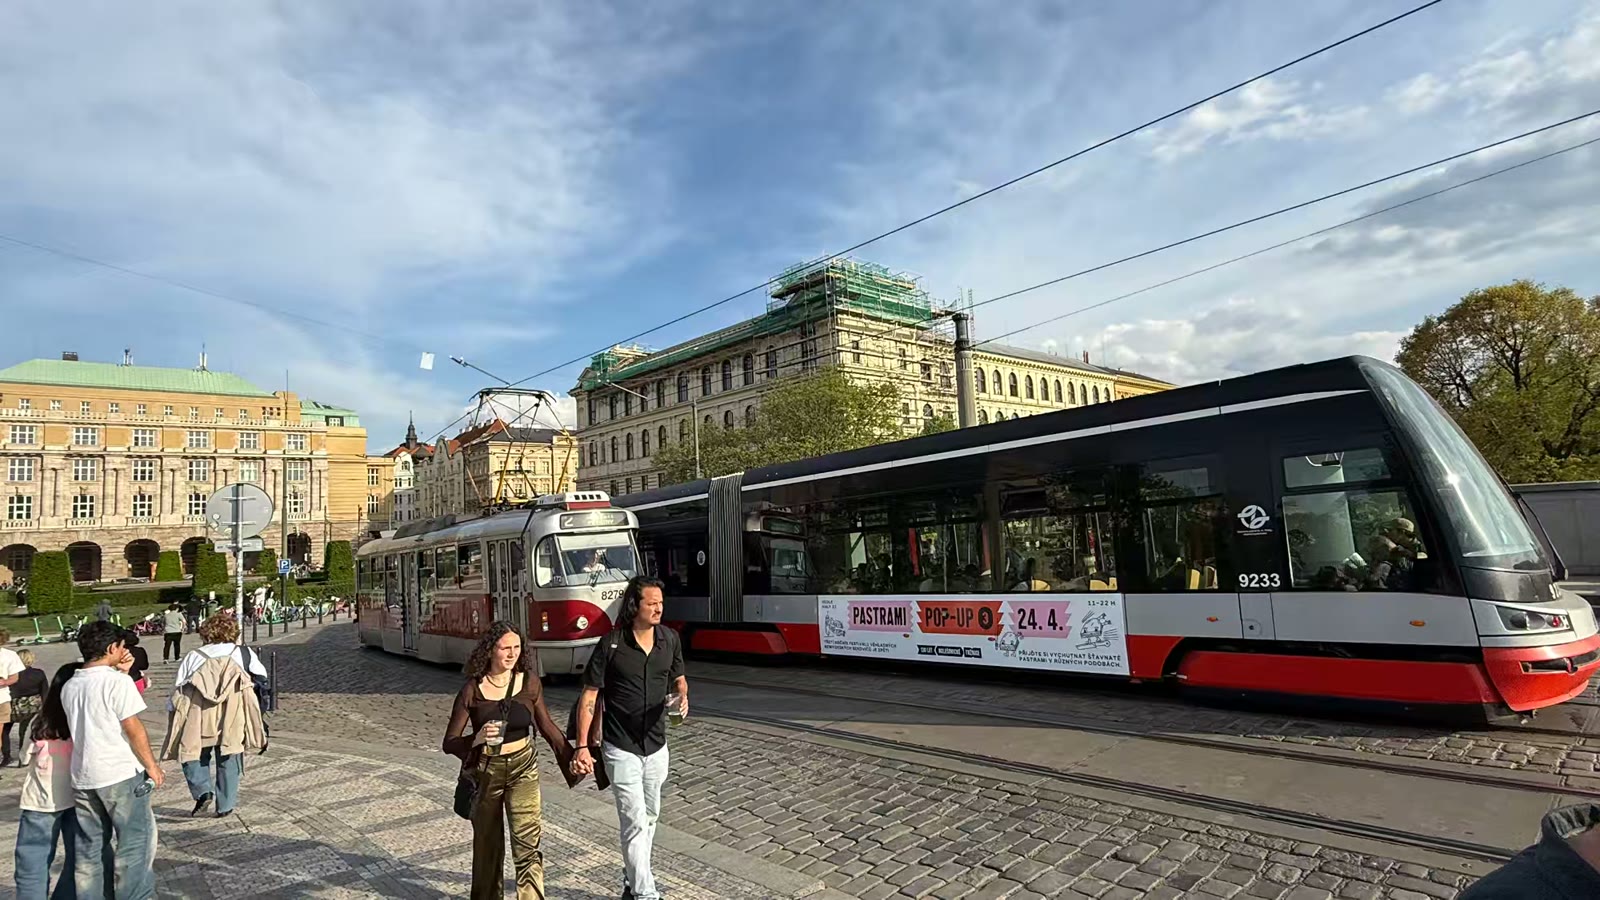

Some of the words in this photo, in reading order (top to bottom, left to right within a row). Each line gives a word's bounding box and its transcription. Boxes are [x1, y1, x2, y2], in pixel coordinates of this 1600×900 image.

[564, 516, 574, 527] 2
[281, 560, 289, 569] P
[1238, 573, 1281, 588] 9233
[601, 589, 625, 601] 8279
[853, 606, 907, 626] PASTRAMI
[925, 606, 974, 628] POP-UP
[1017, 608, 1043, 631] 24.
[1047, 608, 1064, 631] 4.
